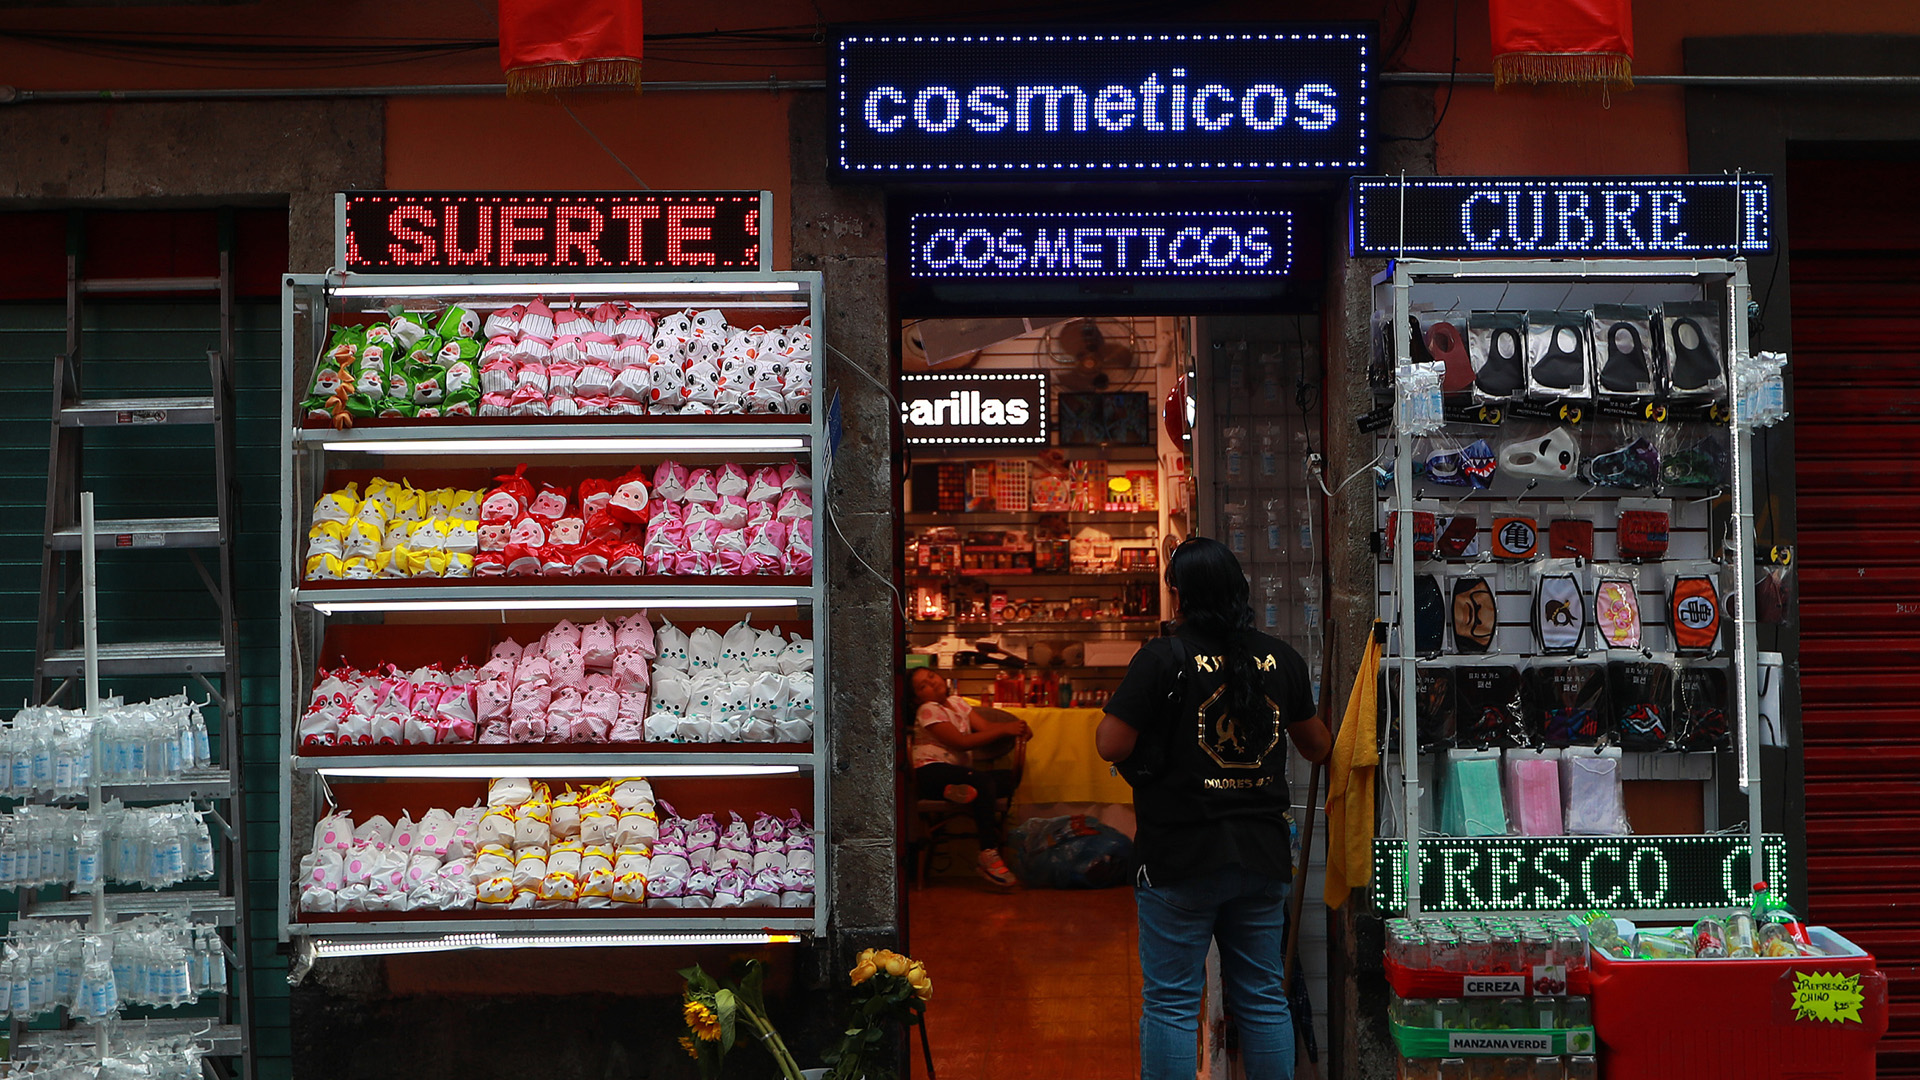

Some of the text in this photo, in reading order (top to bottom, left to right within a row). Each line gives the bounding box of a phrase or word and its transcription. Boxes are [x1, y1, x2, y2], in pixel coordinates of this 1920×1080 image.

[864, 68, 1338, 133] cosmeticos
[388, 205, 717, 266] SUERTE
[1461, 191, 1687, 251] CUBRE
[922, 226, 1272, 269] COSMETICOS
[1204, 778, 1253, 790] DOLORES
[1377, 846, 1668, 907] FRESCO
[1467, 981, 1520, 993] CEREZA
[1800, 992, 1830, 1003] CHINO
[1454, 1039, 1547, 1049] MANZANA VERDE
